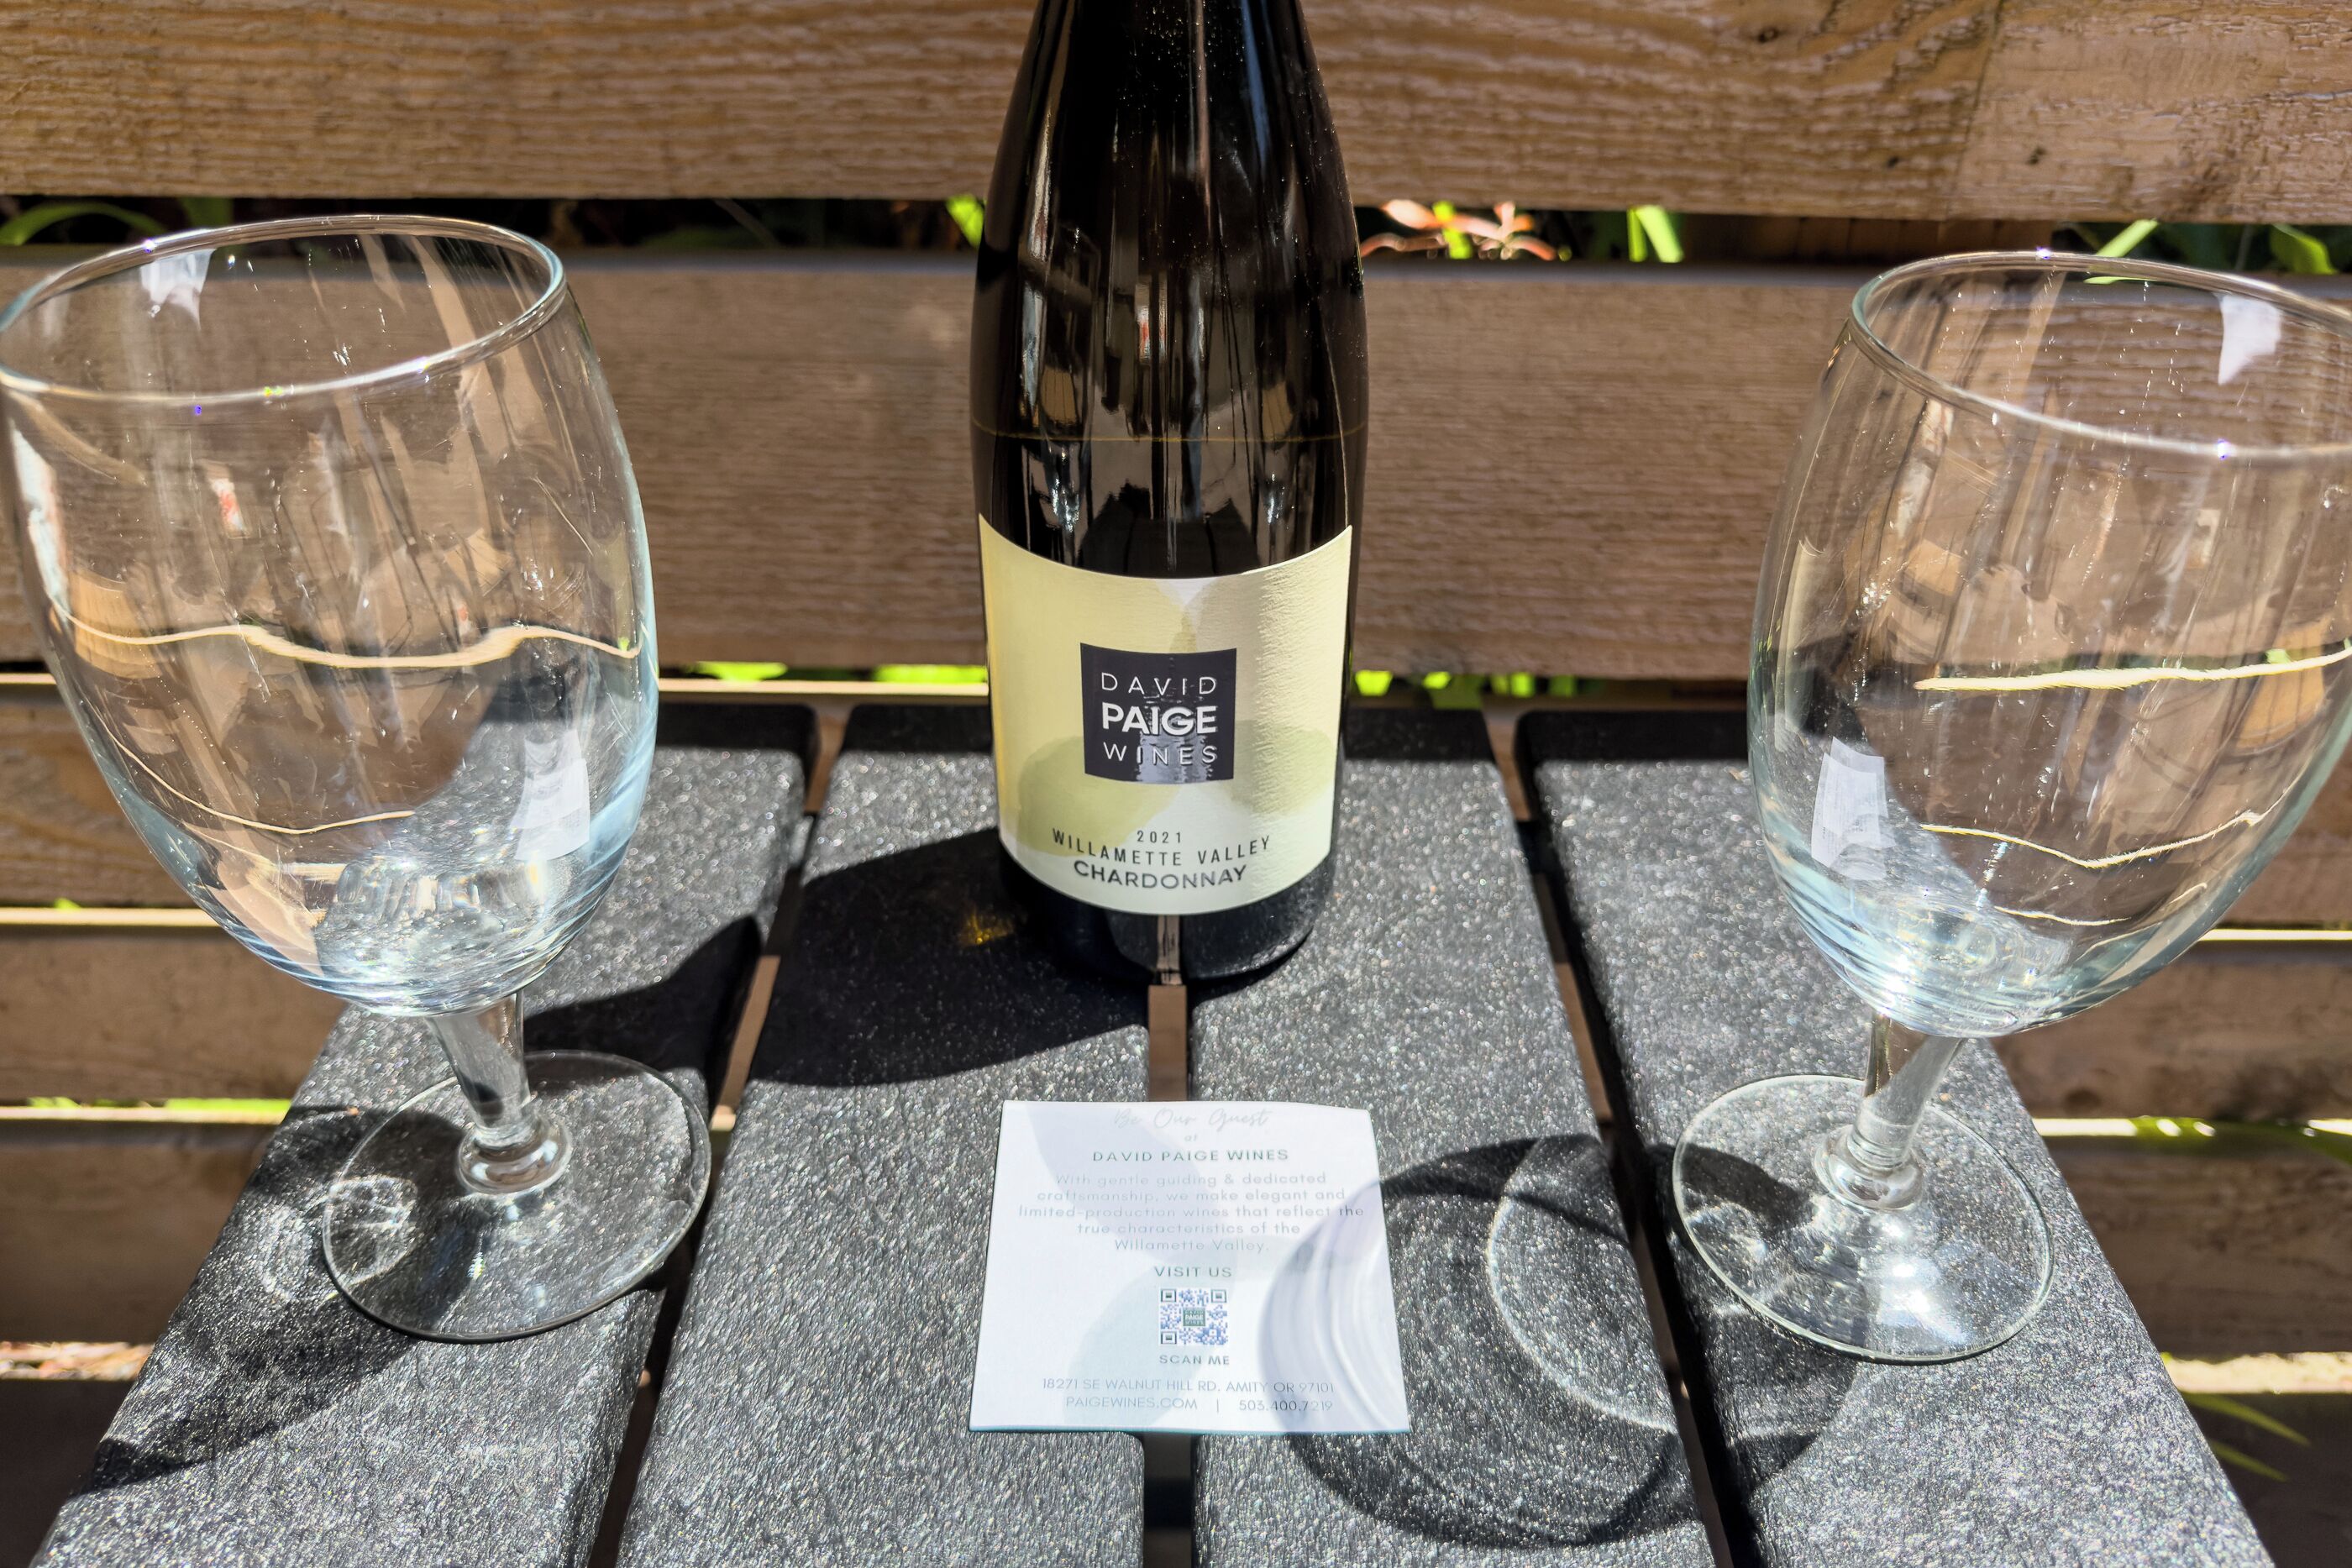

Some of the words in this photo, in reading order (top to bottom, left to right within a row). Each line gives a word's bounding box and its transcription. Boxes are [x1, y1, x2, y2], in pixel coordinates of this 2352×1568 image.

[1101, 673, 1216, 695] DAVID
[1101, 702, 1217, 736] PAIGE
[1103, 742, 1217, 765] WINES
[1137, 830, 1182, 843] 2021
[1053, 827, 1182, 866] WILLAMETTE
[1198, 835, 1270, 865] VALLEY
[1074, 860, 1247, 889] CHARDONNAY
[1114, 1109, 1142, 1125] Be
[1154, 1108, 1196, 1126] Our
[1208, 1109, 1273, 1132] Guest
[1184, 1134, 1199, 1143] at
[1093, 1151, 1152, 1162] DAVID
[1162, 1150, 1218, 1162] PAIGE
[1226, 1149, 1289, 1161] WINES
[1057, 1173, 1091, 1186] With
[1098, 1173, 1149, 1189] gentle
[1156, 1172, 1216, 1188] guiding
[1224, 1173, 1235, 1185] &
[1242, 1172, 1326, 1184] dedicated
[1037, 1189, 1159, 1204] craftsmanship,
[1166, 1192, 1189, 1202] we
[1195, 1189, 1237, 1202] make
[1245, 1189, 1309, 1204] elegant
[1315, 1188, 1345, 1201] and
[1018, 1204, 1175, 1221] limited-production
[1183, 1207, 1229, 1218] wines
[1235, 1205, 1268, 1217] that
[1275, 1204, 1331, 1217] reflect
[1338, 1204, 1364, 1217] the
[1077, 1223, 1110, 1235] true
[1116, 1222, 1243, 1235] characteristics
[1250, 1222, 1268, 1234] of
[1273, 1222, 1300, 1235] the
[1115, 1238, 1205, 1251] Willamette
[1211, 1238, 1269, 1255] Valley.
[1154, 1266, 1200, 1277] VISIT
[1209, 1266, 1232, 1277] US
[1159, 1355, 1202, 1365] SCAN
[1208, 1355, 1230, 1366] ME
[1042, 1378, 1079, 1390] 18271
[1083, 1378, 1100, 1390] SE
[1105, 1378, 1162, 1391] WALNUT
[1167, 1379, 1194, 1391] HILL
[1198, 1380, 1221, 1392] RD.
[1226, 1381, 1268, 1392] AMITY
[1273, 1382, 1294, 1393] OR
[1299, 1382, 1335, 1393] 97101
[1066, 1396, 1198, 1409] PAIGEWINES.COM
[1238, 1399, 1333, 1412] 503.400.7219
